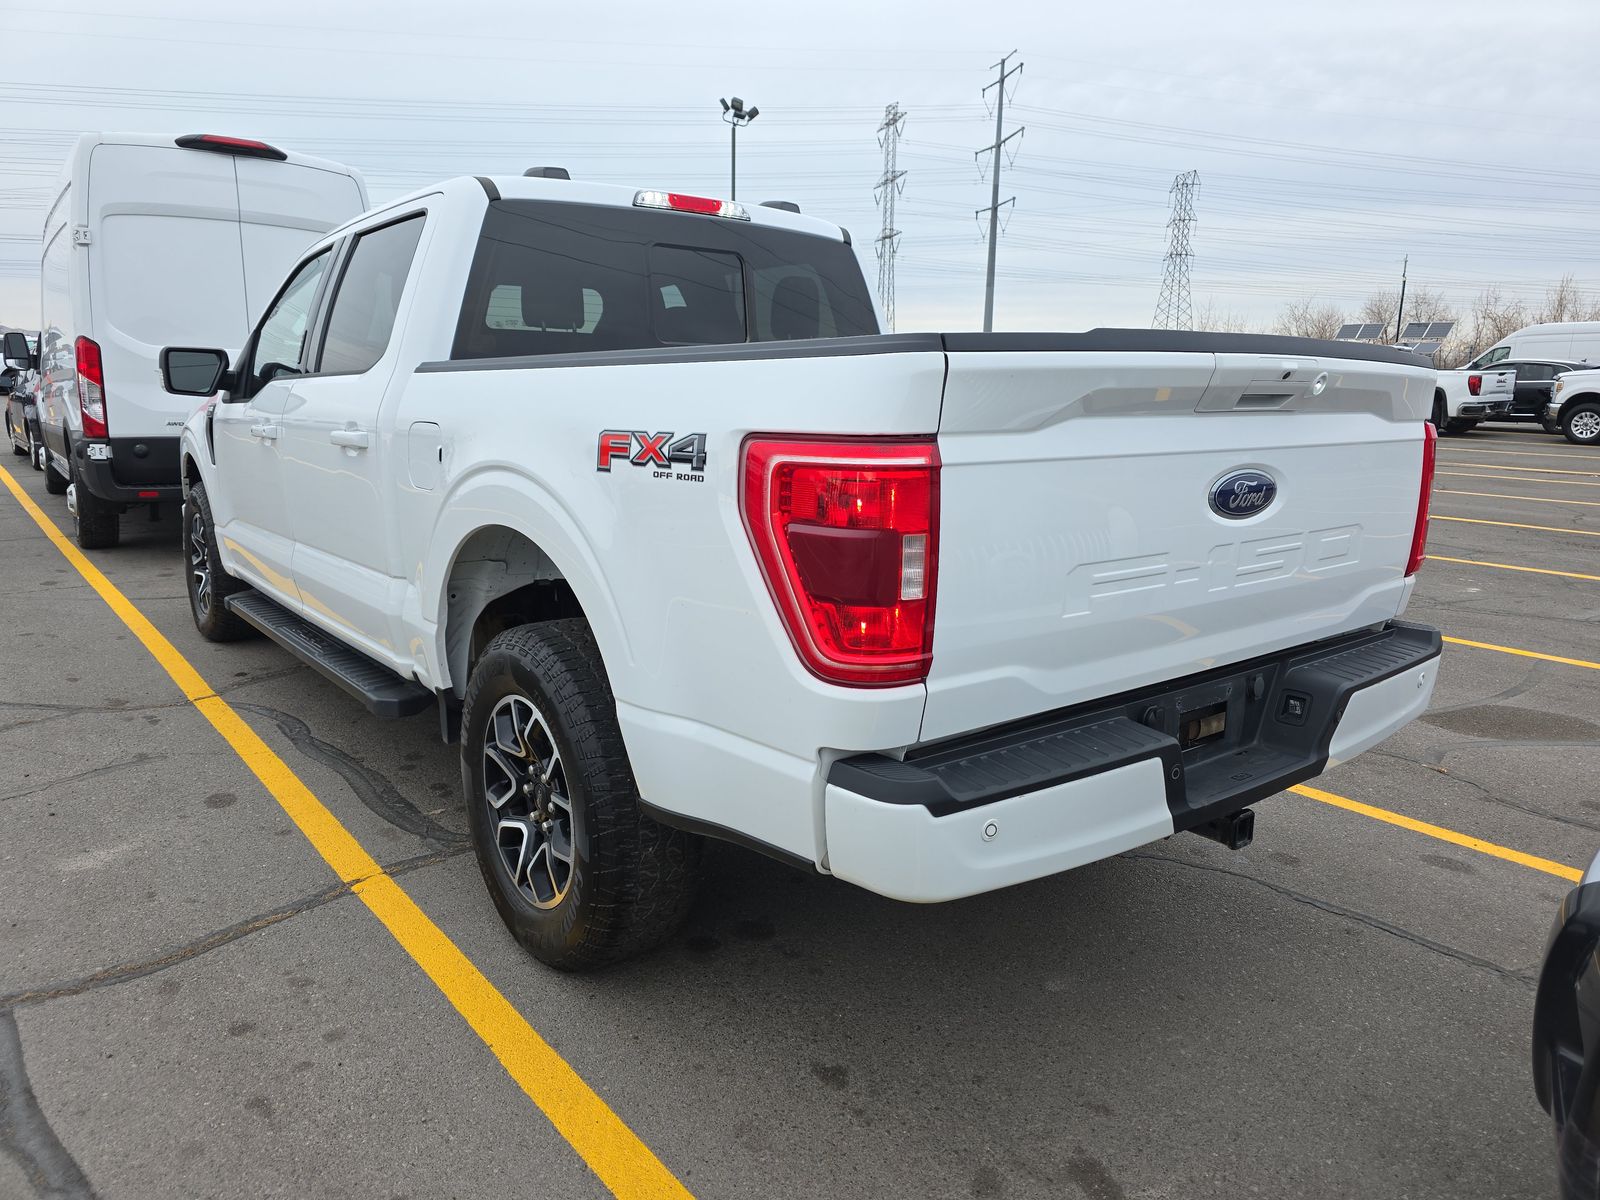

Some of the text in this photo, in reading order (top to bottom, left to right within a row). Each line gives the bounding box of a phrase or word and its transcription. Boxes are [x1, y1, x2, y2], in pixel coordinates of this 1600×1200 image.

[597, 429, 707, 473] FX4
[652, 471, 705, 483] OFF ROAD
[1229, 480, 1266, 509] Ford
[1062, 523, 1363, 618] F-150
